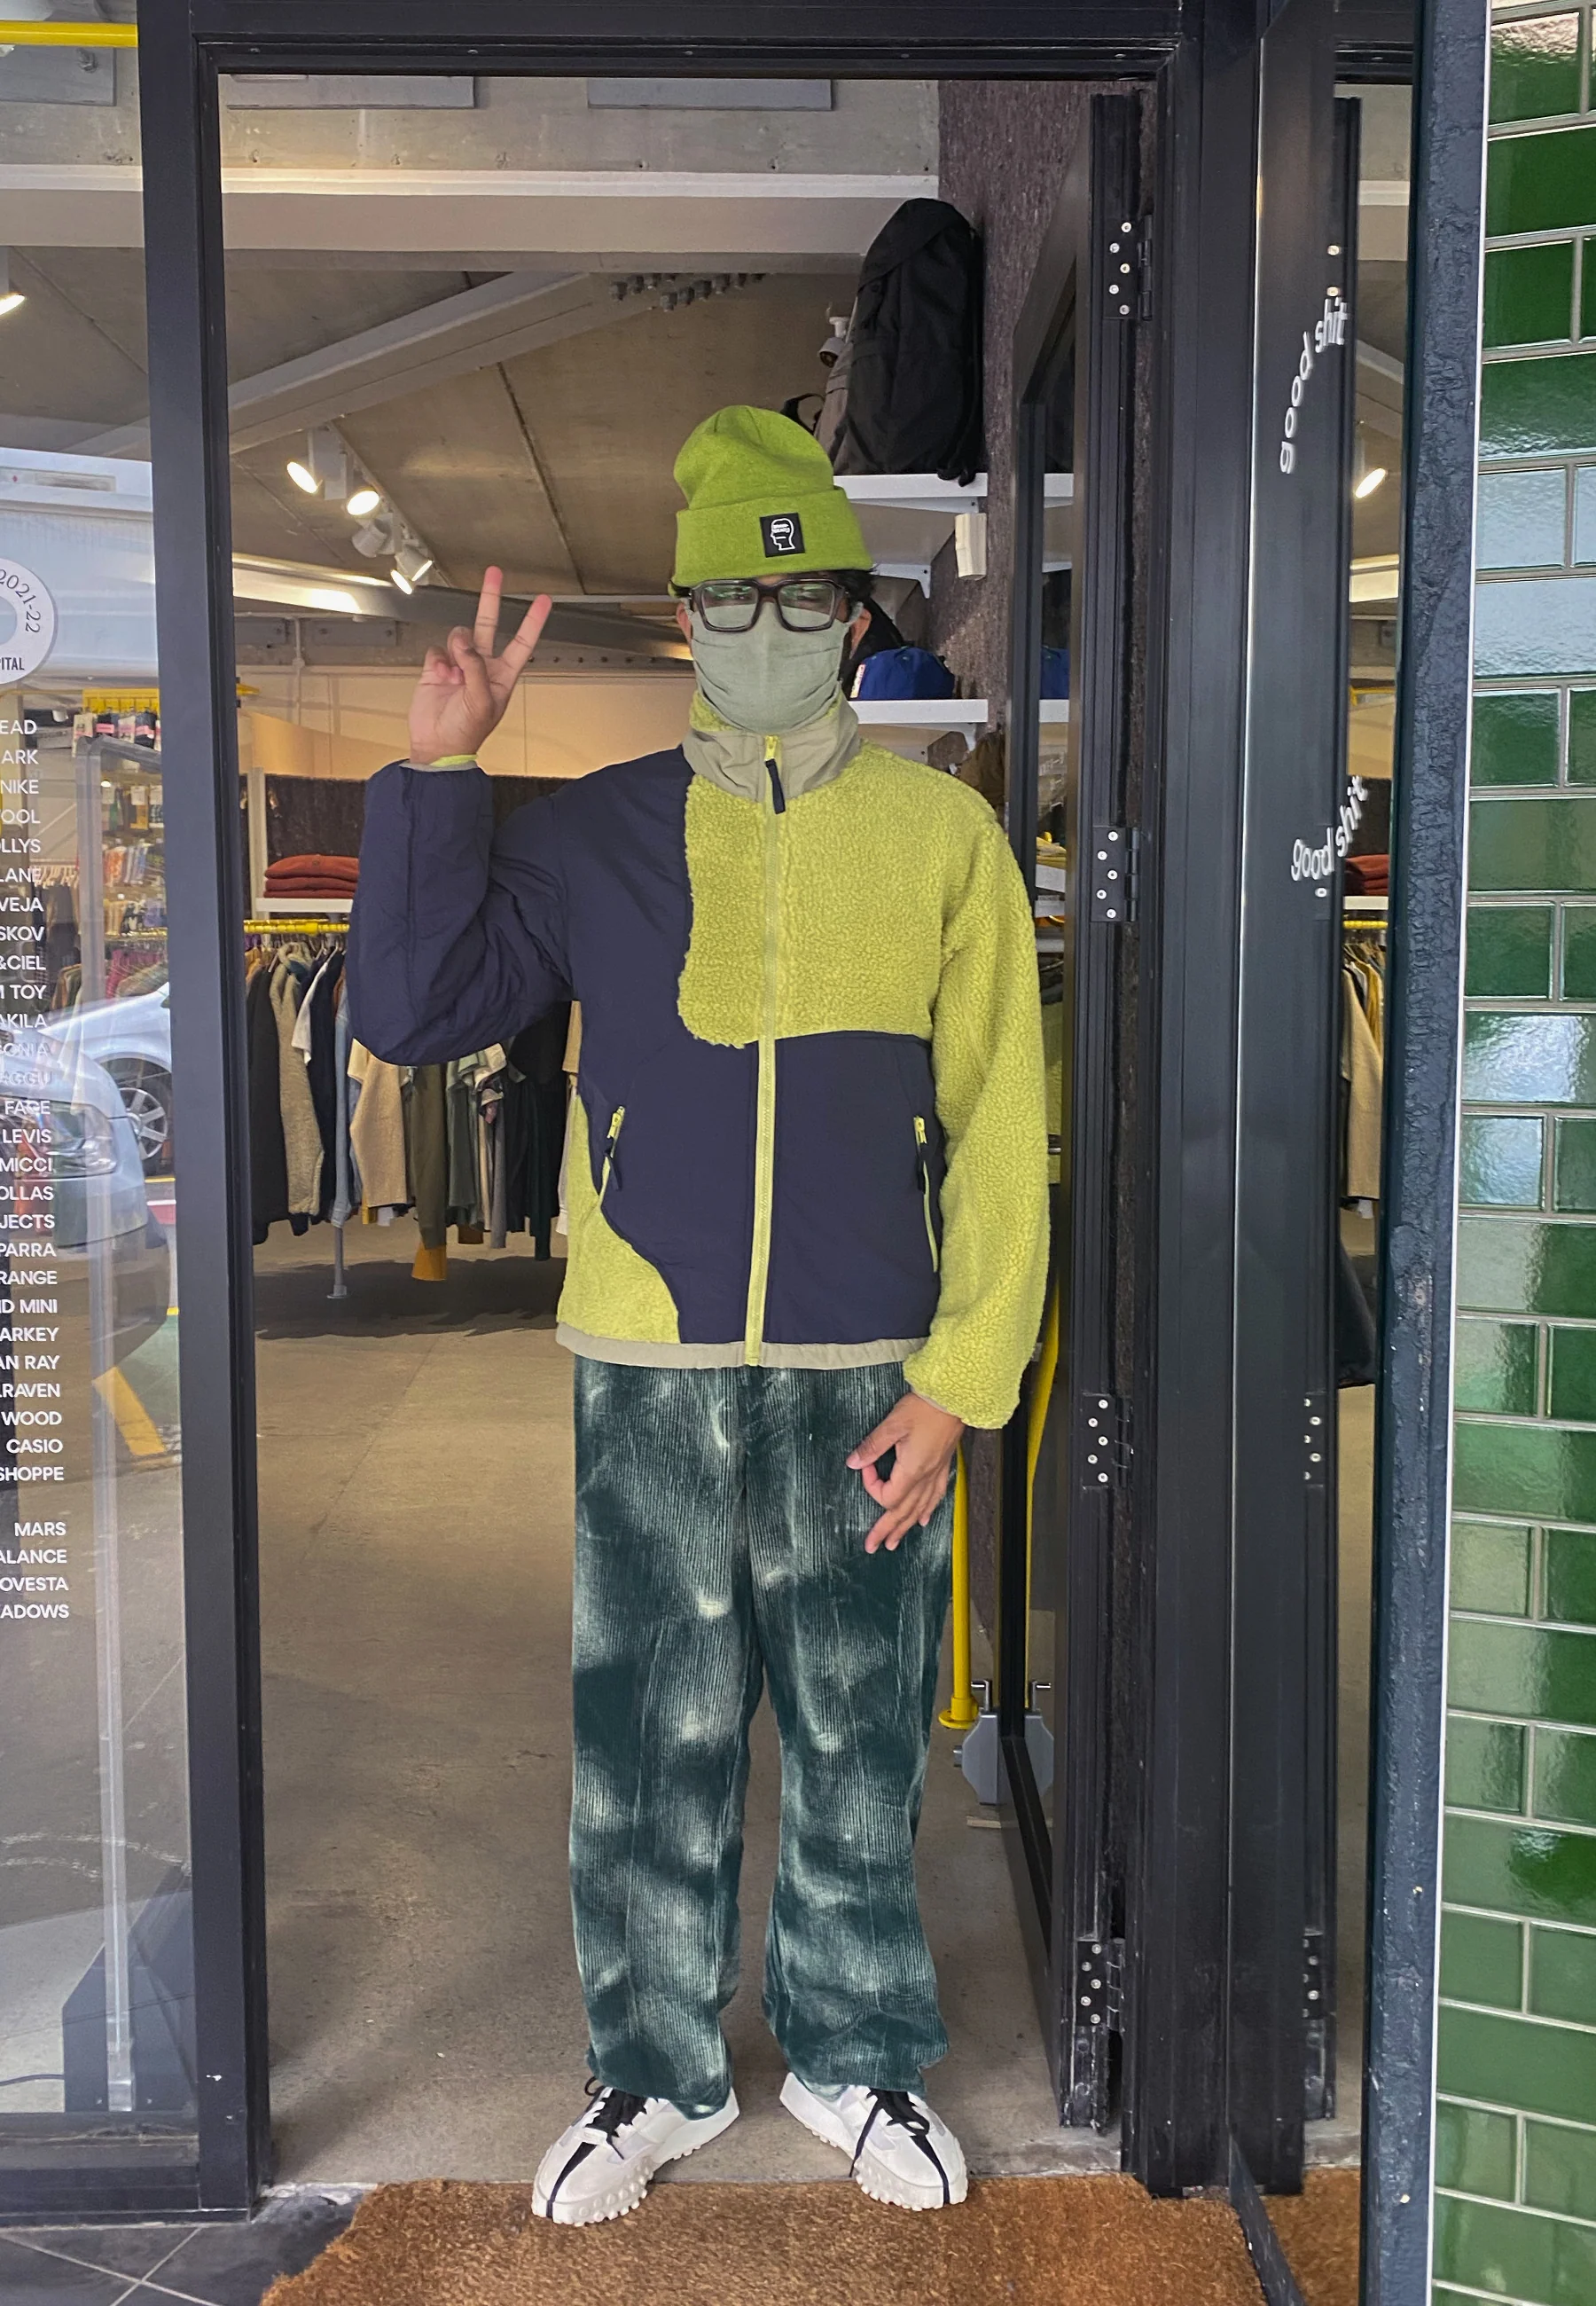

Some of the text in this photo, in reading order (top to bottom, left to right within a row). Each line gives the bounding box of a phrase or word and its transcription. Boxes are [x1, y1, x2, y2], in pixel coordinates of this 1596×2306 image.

[1279, 296, 1348, 475] good shit
[0, 657, 25, 671] ITAL
[1, 749, 39, 765] ARK
[0, 780, 40, 795] NIKE
[0, 809, 42, 824] OOL
[1291, 775, 1369, 881] good shit
[0, 838, 42, 853] LLYS
[0, 897, 44, 912] VEJA
[10, 984, 47, 1000] TOY
[3, 1129, 52, 1144] LEVIS
[0, 1243, 57, 1257] PARRA
[20, 1298, 58, 1314] MINI
[0, 1327, 59, 1342] ARKEY
[24, 1355, 60, 1370] RAY
[0, 1383, 61, 1398] RAVEN
[1, 1410, 62, 1426] WOOD
[6, 1439, 64, 1454] CASIO
[14, 1521, 66, 1537] MARS
